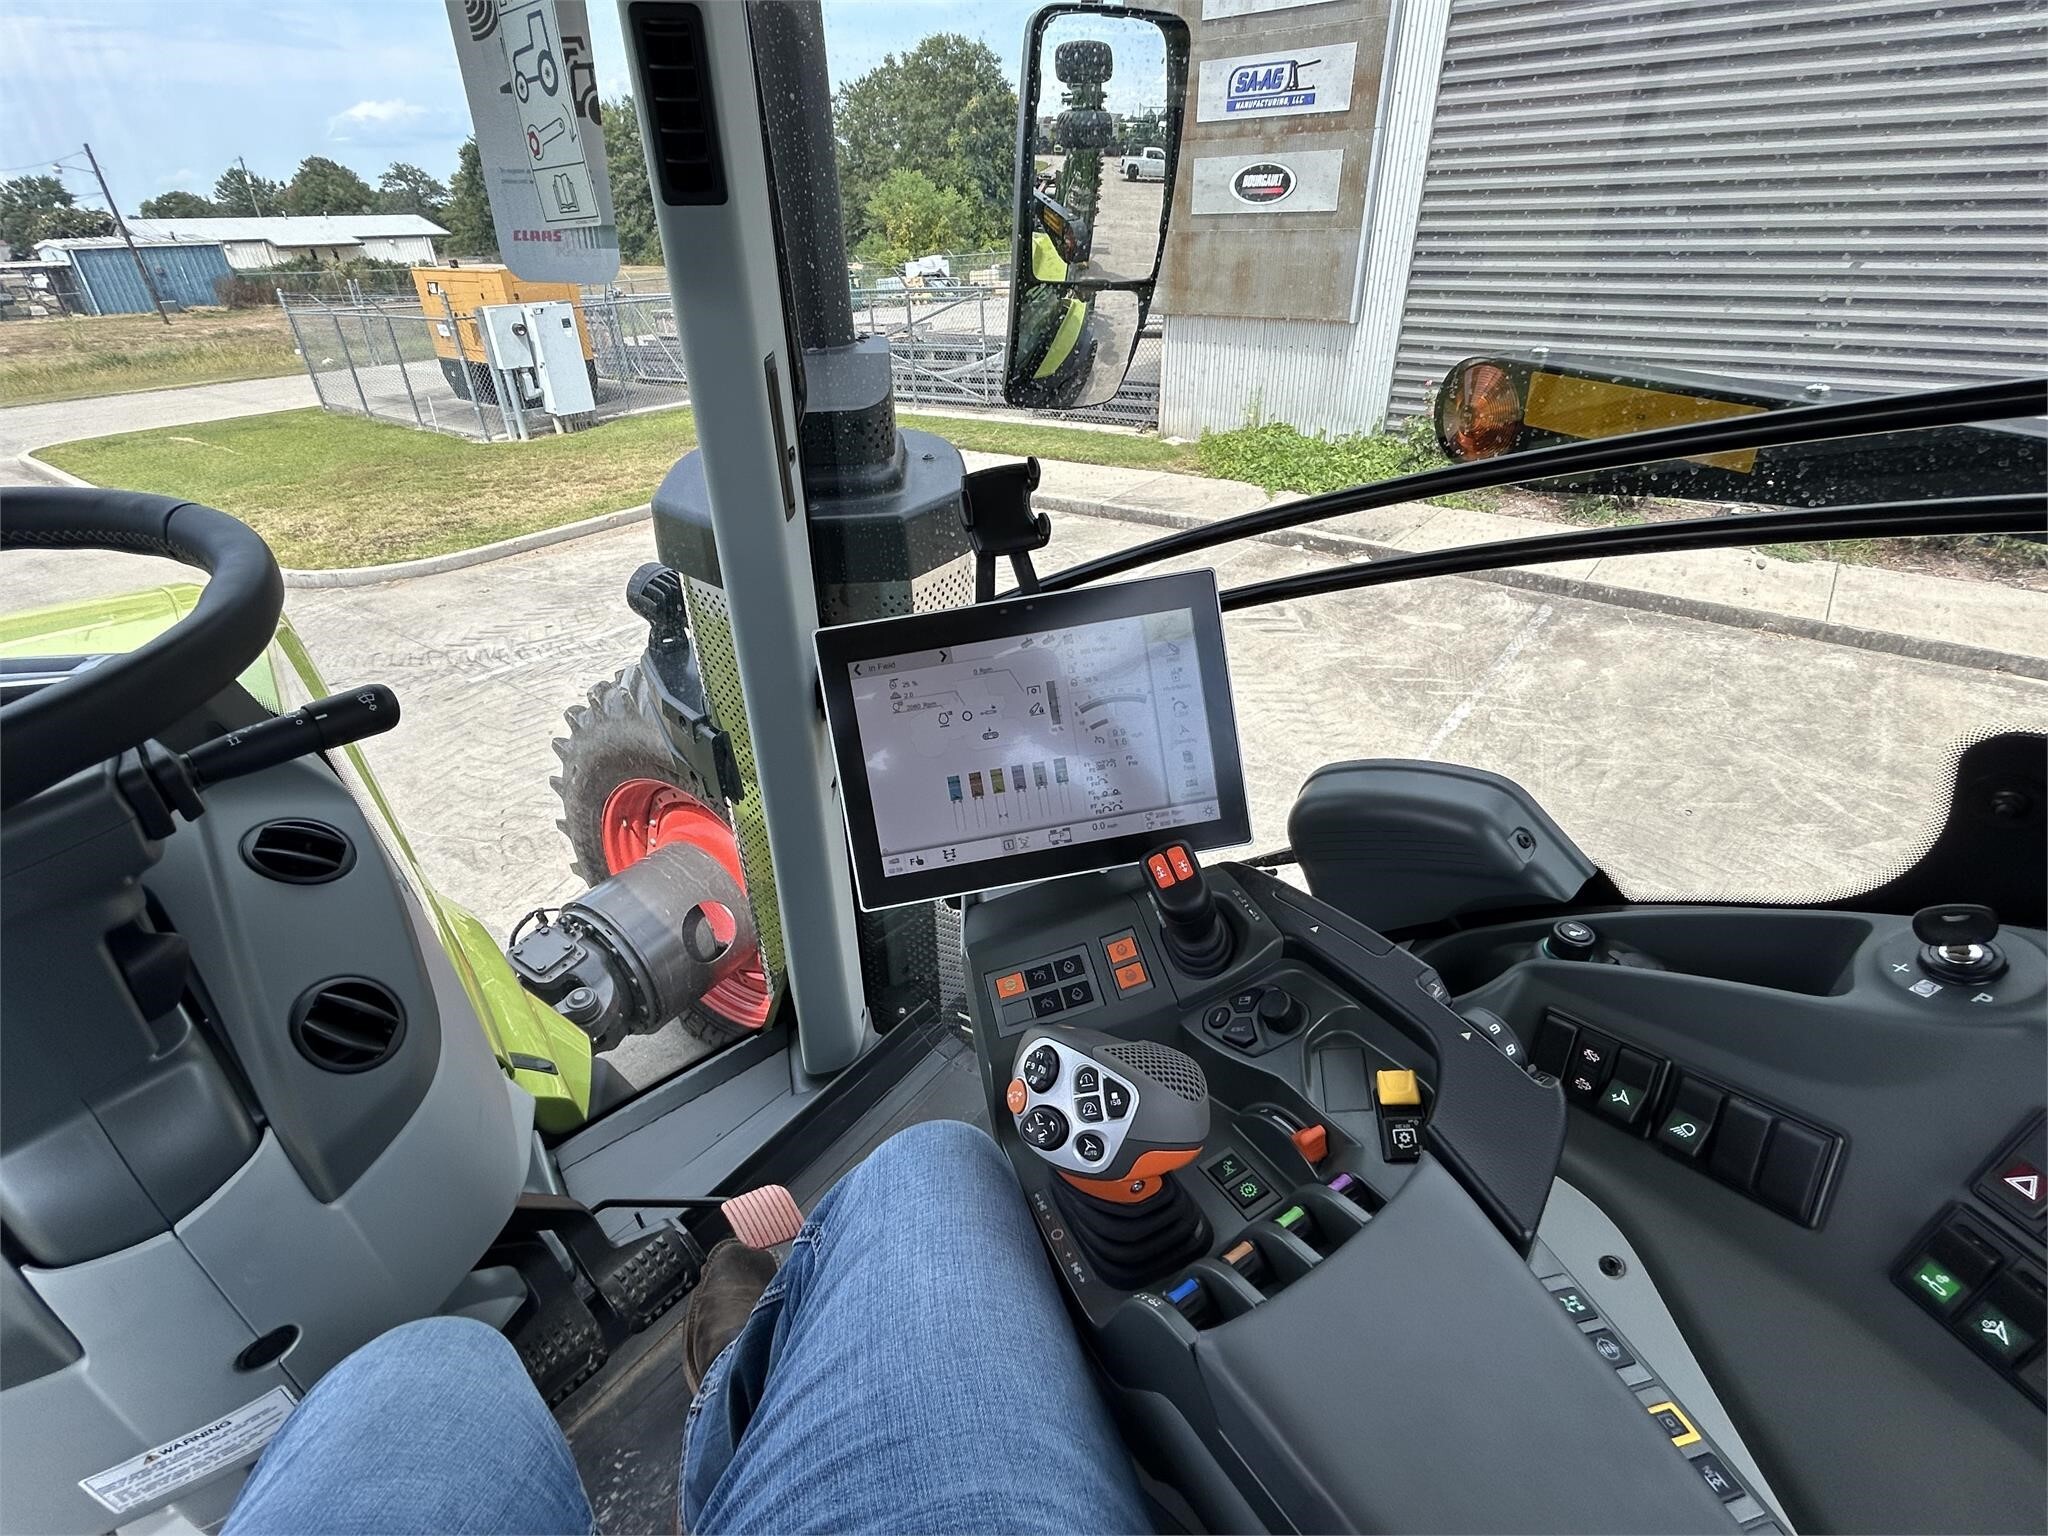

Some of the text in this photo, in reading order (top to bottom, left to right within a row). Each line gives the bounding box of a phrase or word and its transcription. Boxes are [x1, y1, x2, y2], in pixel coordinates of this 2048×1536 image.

[1235, 67, 1284, 93] SA-AG
[1235, 95, 1305, 109] MANUFACTURING, LLC
[1242, 173, 1284, 188] BOURGAULT
[513, 229, 562, 242] CLAAS
[1970, 992, 1993, 1002] P
[1506, 1043, 1516, 1056] 8
[159, 1420, 232, 1455] WARNING
